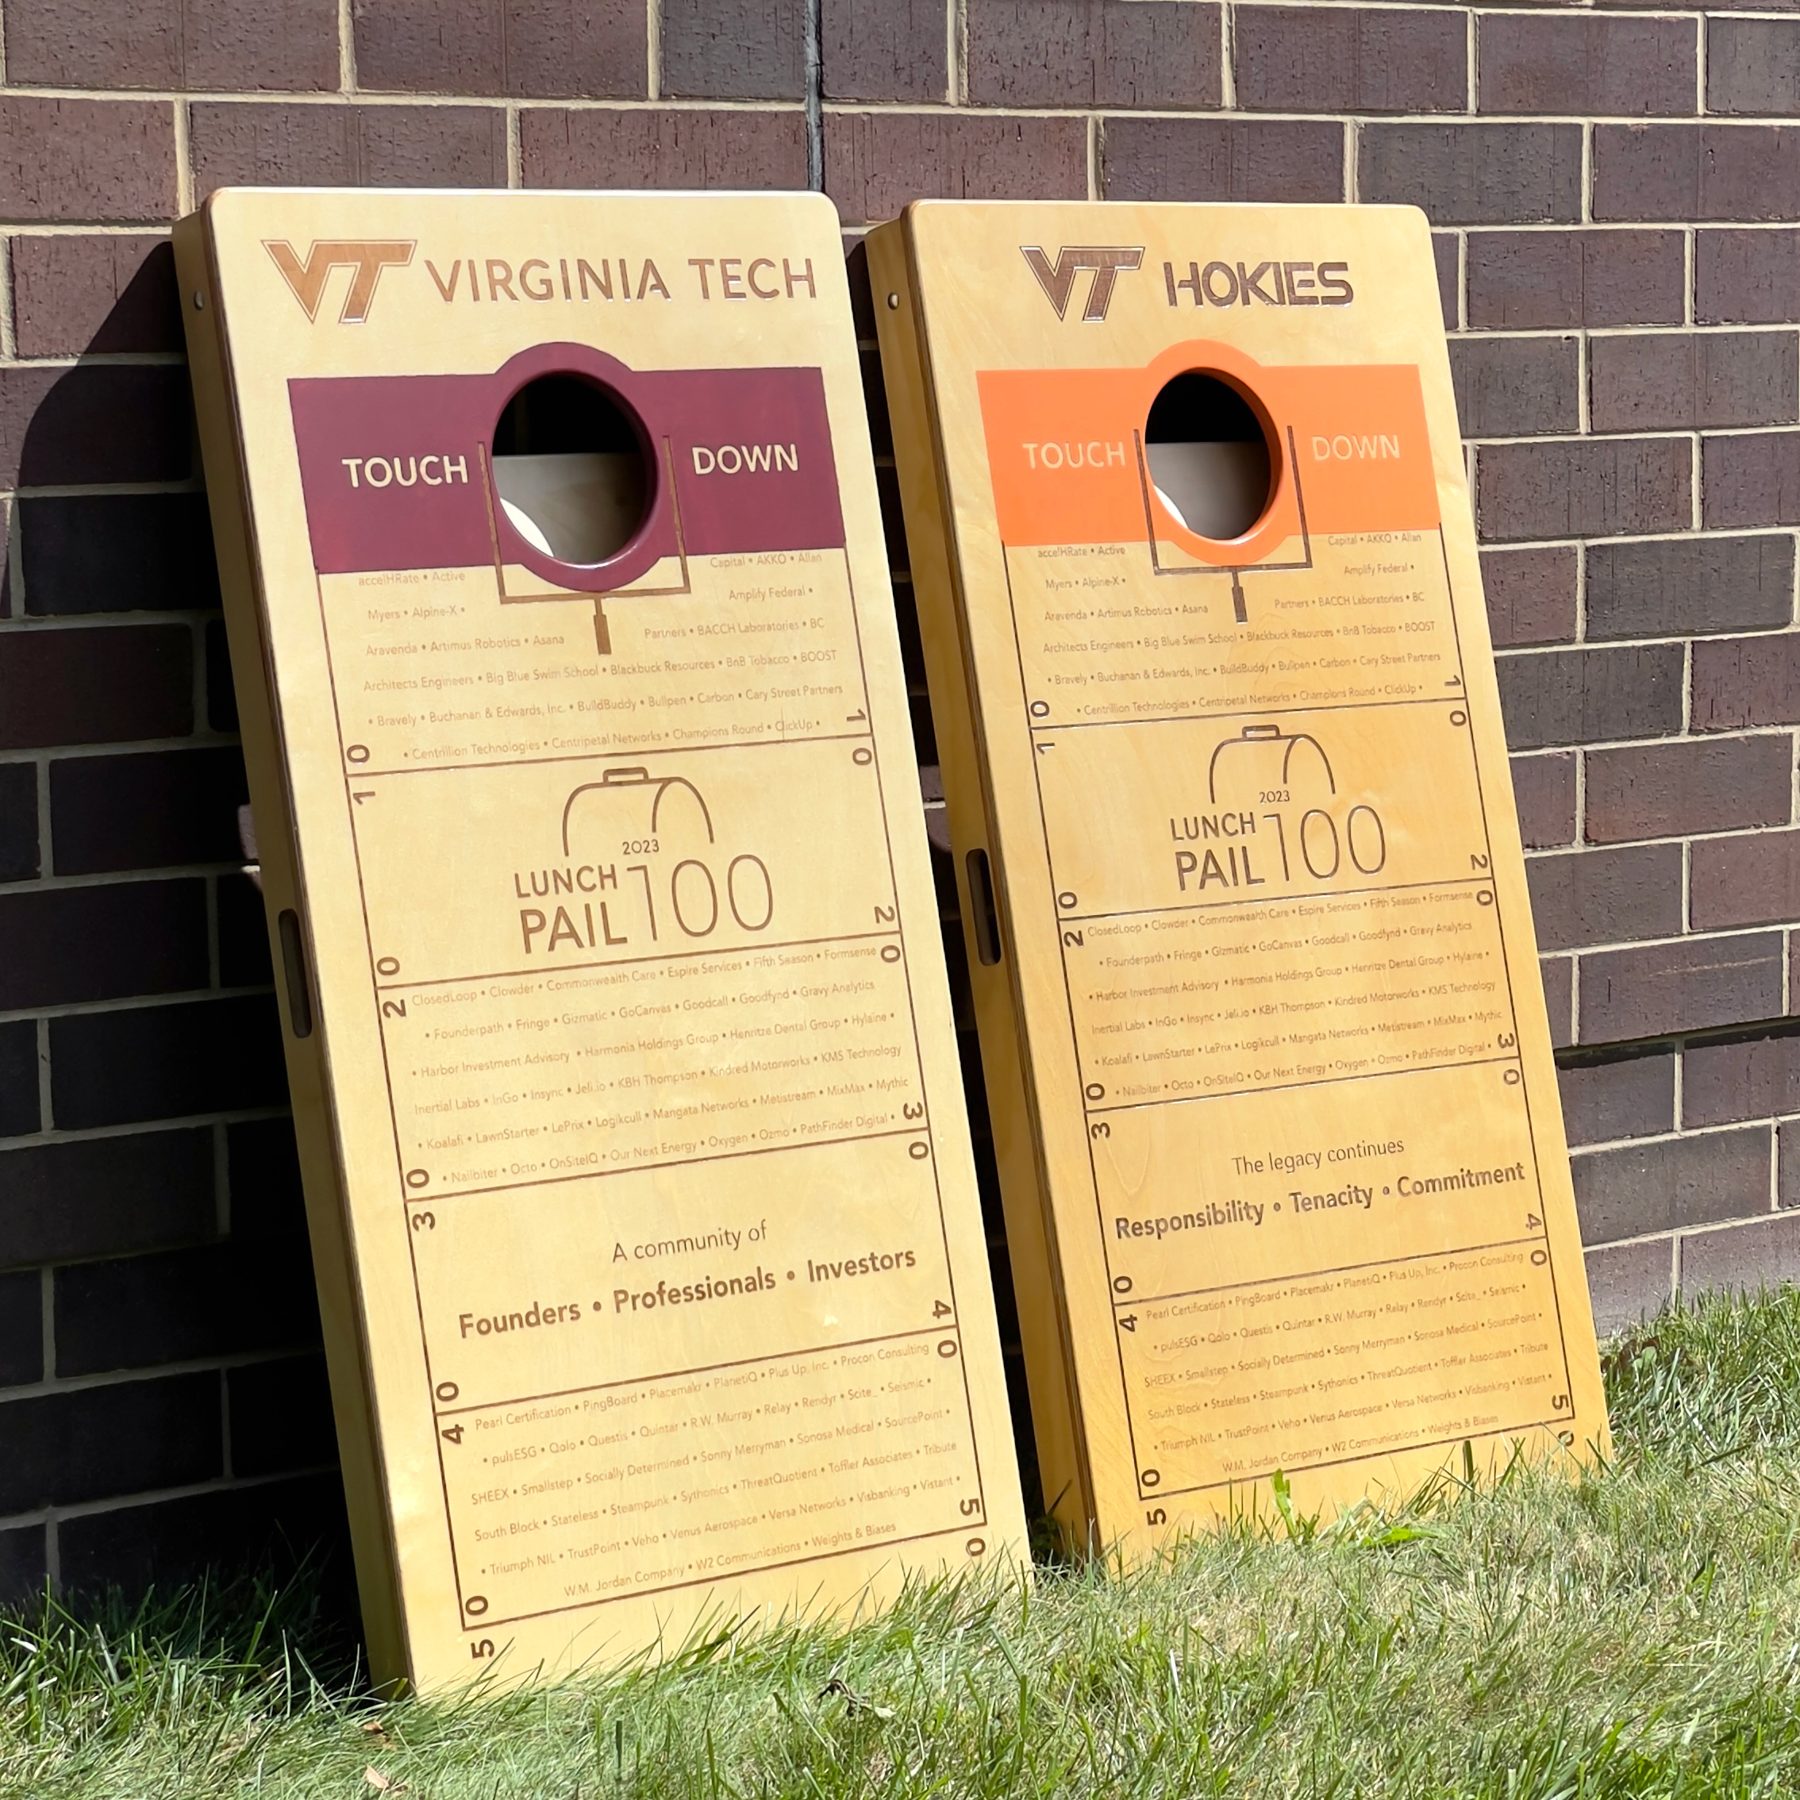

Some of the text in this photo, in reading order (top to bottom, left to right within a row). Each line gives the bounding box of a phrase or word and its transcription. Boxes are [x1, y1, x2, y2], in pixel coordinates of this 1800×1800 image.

[260, 239, 818, 324] VT VIRGINIA TECH
[1019, 245, 1355, 323] VT HOKIES
[341, 443, 799, 489] TOUCH DOWN
[1022, 434, 1401, 470] TOUCH DOWN
[430, 571, 466, 582] Active
[709, 555, 746, 571] Capital
[755, 553, 787, 566] AKKO
[797, 552, 822, 564] Allan
[366, 583, 806, 624] Myers Alpine-X Amplify Federal
[362, 648, 837, 692] Architects Engineers Big Blue Swim School Blackbuck Resources BnB Tobacco BOOST
[410, 744, 468, 760] Centrillion
[470, 739, 541, 756] Technologies
[611, 729, 662, 745] Networks
[671, 725, 729, 741] Champions
[730, 720, 764, 735] Round
[773, 717, 813, 737] ClickUp
[1258, 789, 1291, 804] 2023
[621, 838, 660, 855] 2023
[1170, 811, 1257, 841] LUNCH
[1175, 805, 1387, 892] PAIL 100
[513, 862, 619, 899] LUNCH
[519, 854, 774, 954] PAIL 100
[419, 1062, 459, 1078] Harbor
[460, 1055, 522, 1073] Investment
[523, 1050, 570, 1065] Advisory
[583, 1040, 636, 1057] Harmonia
[636, 1036, 684, 1051] Holdings
[685, 1032, 719, 1046] Group
[773, 1017, 807, 1035] Dental
[808, 1017, 841, 1031] Group
[474, 1126, 539, 1144] LawnStarter
[550, 1118, 585, 1134] LePrix
[594, 1110, 642, 1130] Logikcull
[650, 1105, 699, 1120] Mangata
[699, 1096, 749, 1114] Networks
[825, 1082, 865, 1096] MixMax
[875, 1075, 909, 1093] Mythic
[1231, 1139, 1406, 1176] The legacy continues
[1115, 1161, 1527, 1240] Responsibility Tenacity Commitment
[612, 1219, 768, 1264] A community of
[458, 1246, 917, 1340] Founders Professionals Investors
[470, 1486, 510, 1506] SHEEX
[520, 1478, 574, 1497] Smallstep
[583, 1466, 625, 1485] Socially
[625, 1453, 690, 1477] Determined
[699, 1448, 733, 1464] Sonny
[733, 1438, 786, 1456] Merryman
[834, 1418, 874, 1437] Medical
[883, 1408, 943, 1429] SourcePoint
[489, 1555, 534, 1575] Triumph
[535, 1552, 555, 1566] NIL
[566, 1540, 621, 1559] TrustPoint
[630, 1532, 659, 1547] Veho
[669, 1525, 702, 1540] Venus
[703, 1514, 758, 1533] Aerospace
[767, 1507, 797, 1521] Versa
[798, 1495, 847, 1515] Networks
[856, 1484, 911, 1503] Visbanking
